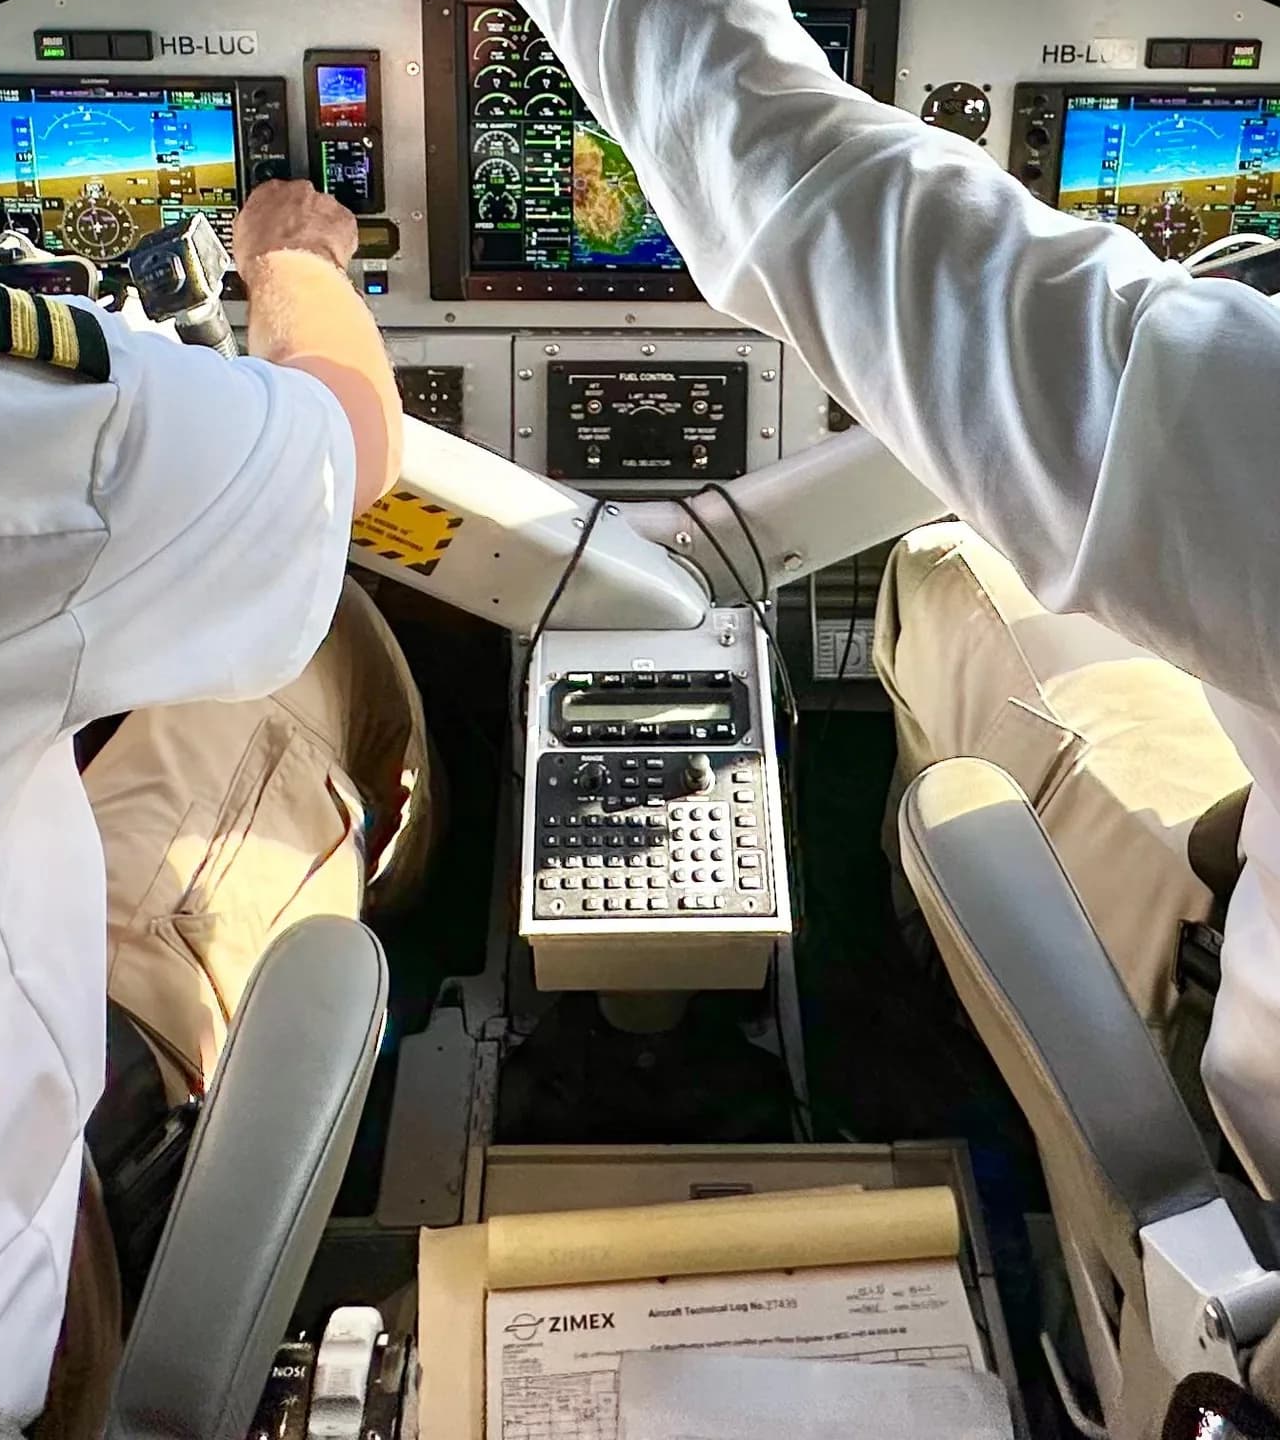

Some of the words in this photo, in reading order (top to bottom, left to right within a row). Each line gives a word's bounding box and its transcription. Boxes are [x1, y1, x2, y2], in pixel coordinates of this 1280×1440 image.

[160, 35, 256, 56] HB-LUC
[619, 372, 639, 381] FUEL
[648, 1307, 682, 1318] Aircraft
[684, 1303, 728, 1315] Technical
[729, 1303, 749, 1312] Log
[548, 1312, 615, 1333] ZIMEX
